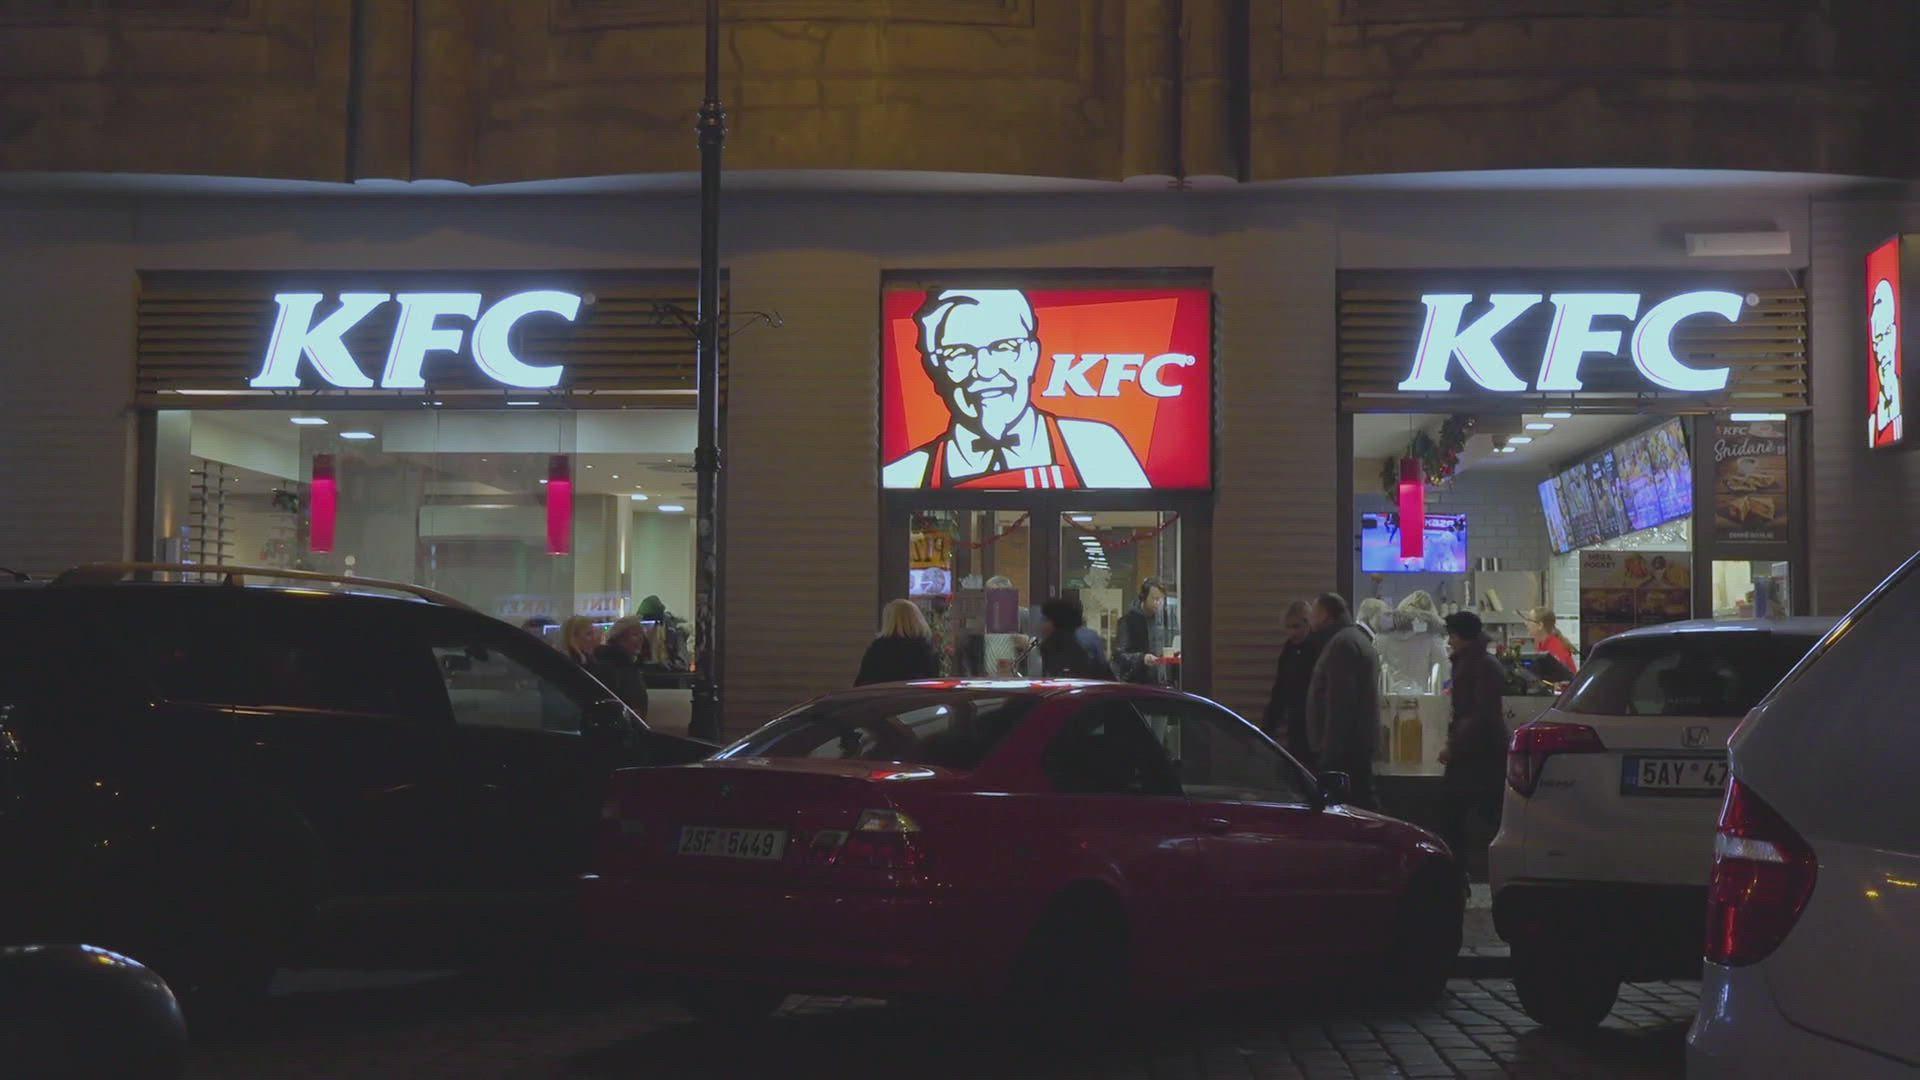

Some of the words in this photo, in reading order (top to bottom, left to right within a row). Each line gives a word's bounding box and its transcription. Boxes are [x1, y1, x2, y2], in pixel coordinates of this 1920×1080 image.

[250, 290, 582, 389] KFC
[1398, 291, 1744, 392] KFC
[1042, 353, 1193, 398] KFC
[1723, 426, 1748, 436] KFC
[1643, 762, 1685, 786] 5AY
